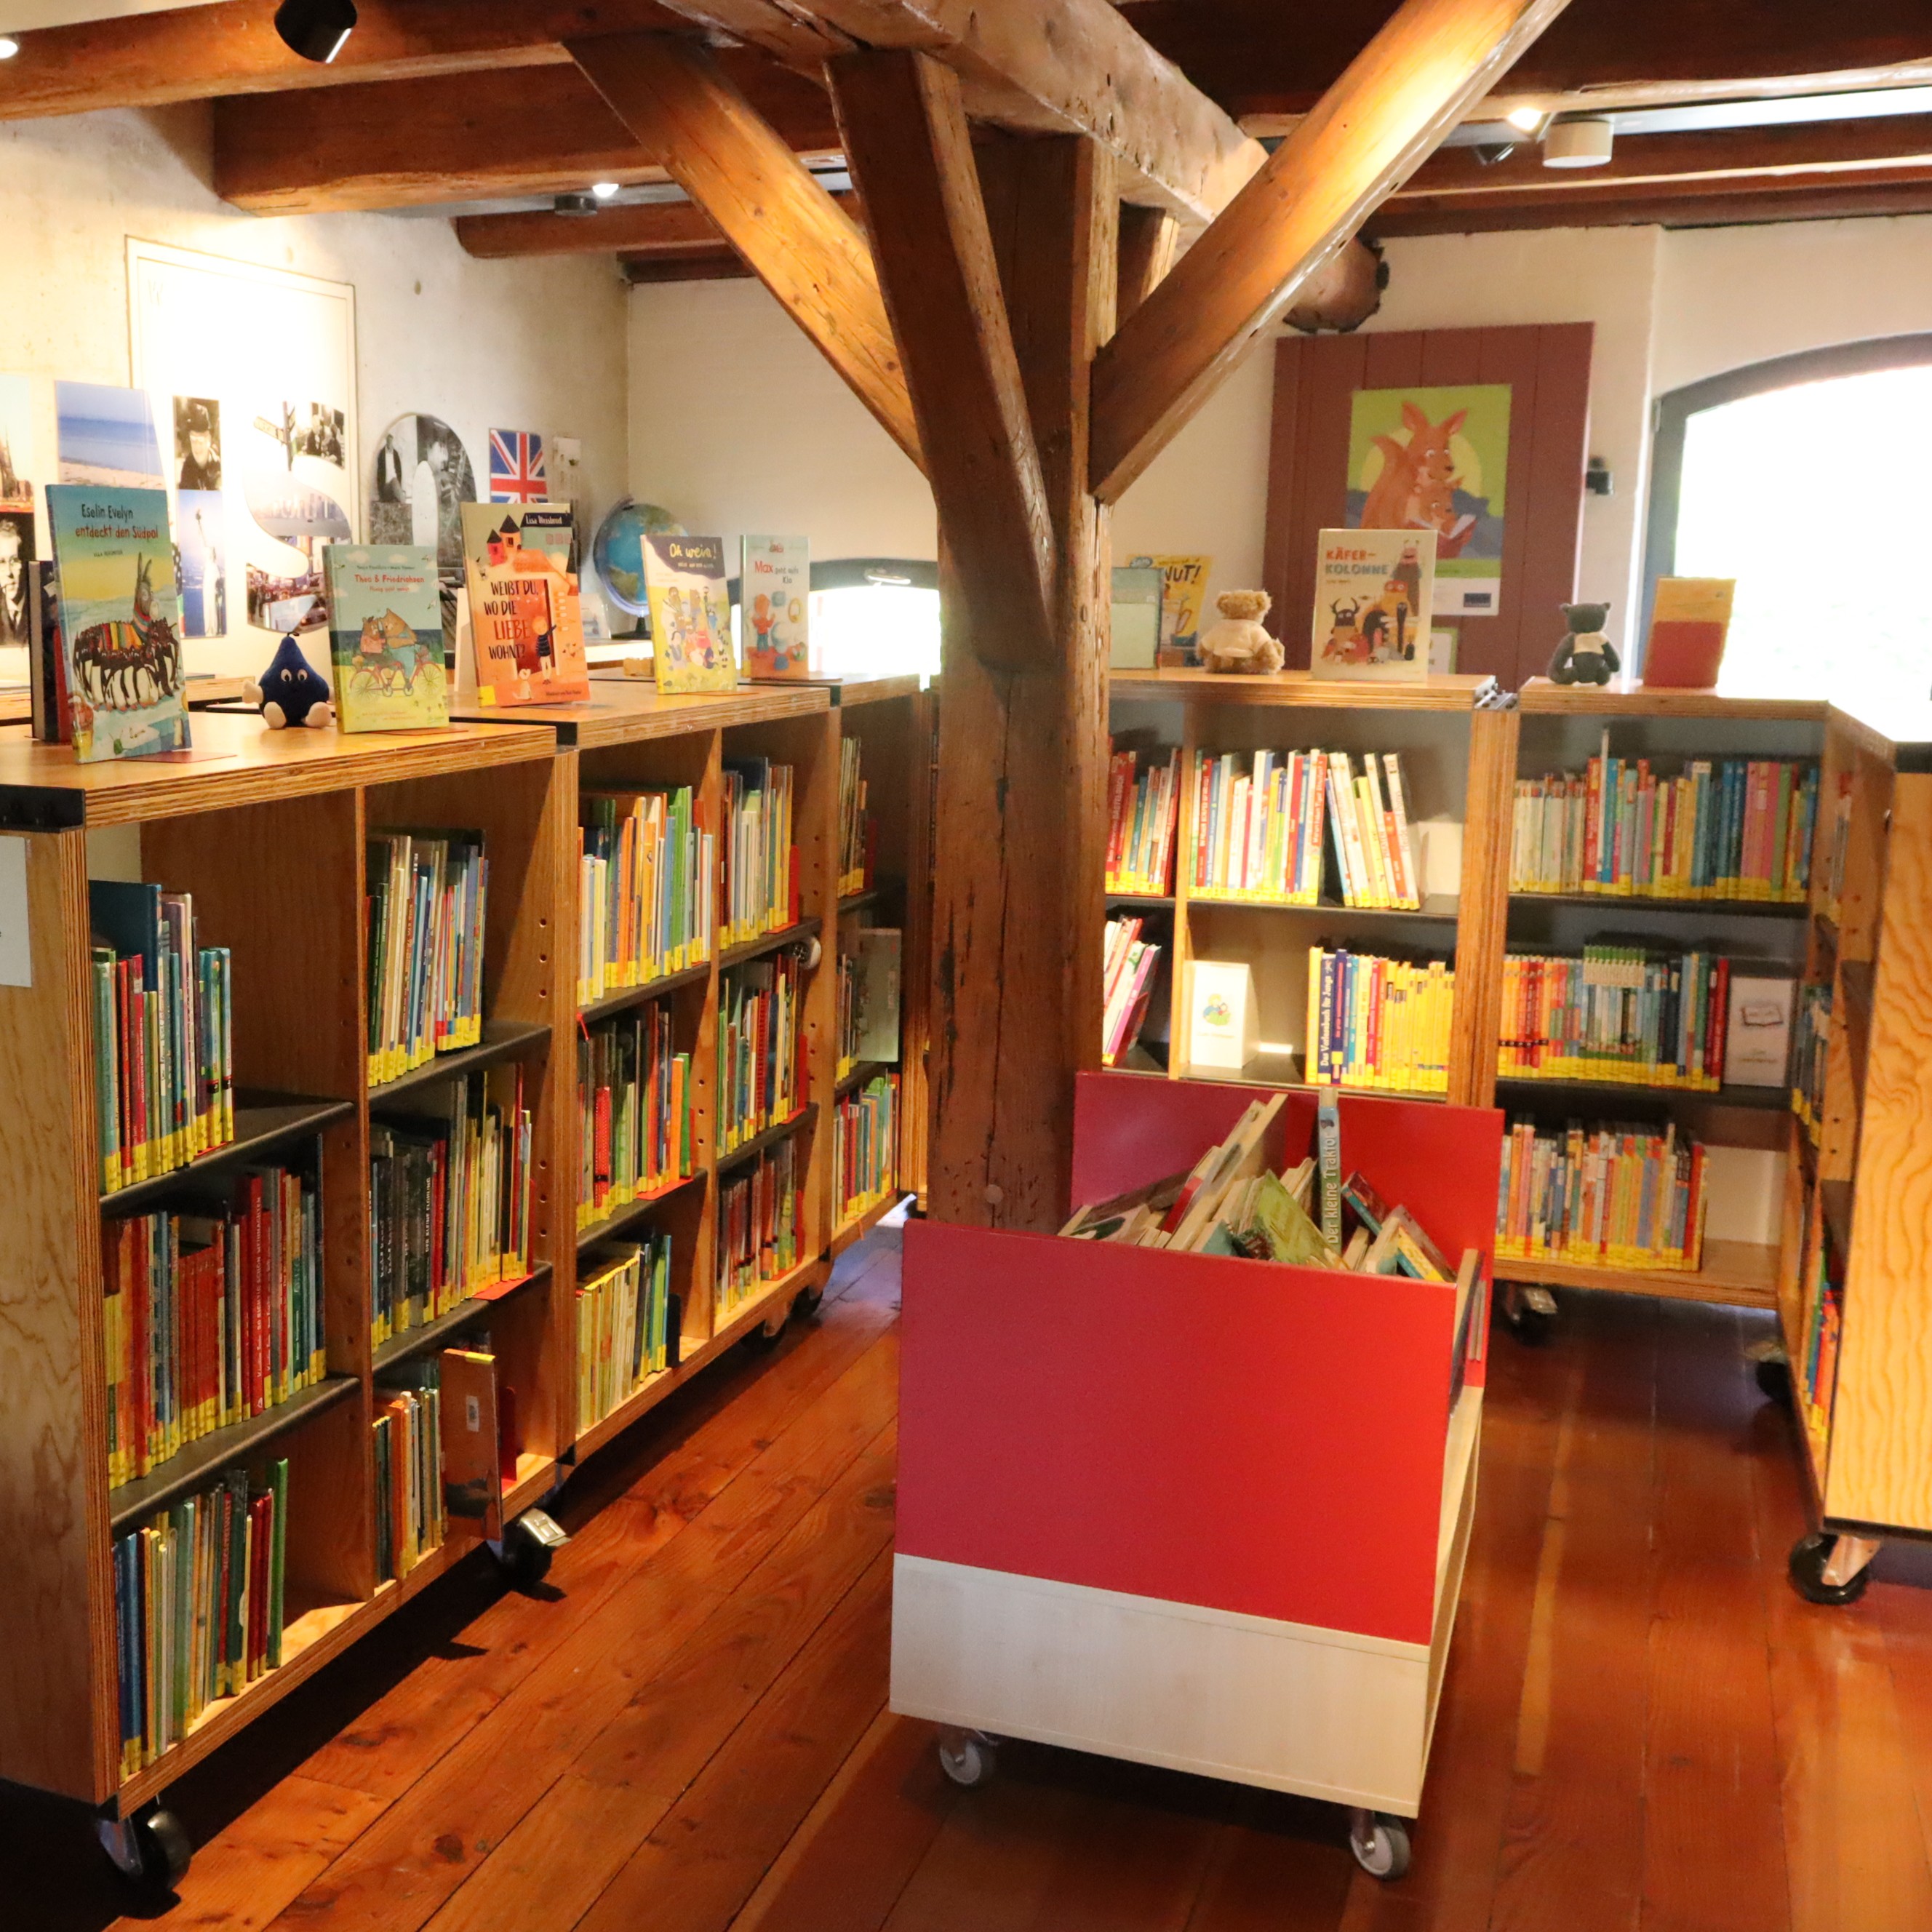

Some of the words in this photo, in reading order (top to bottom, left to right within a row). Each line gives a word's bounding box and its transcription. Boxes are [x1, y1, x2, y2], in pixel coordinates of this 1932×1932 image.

[81, 503, 105, 519] Eselin
[108, 505, 134, 523] Evelyn
[525, 514, 538, 524] Lisa
[75, 524, 112, 538] entdeckt
[116, 524, 129, 538] den
[132, 524, 158, 542] Südpol
[1326, 547, 1376, 560] KÄFER-
[755, 560, 773, 573] Max
[1325, 564, 1388, 575] KOLONNE
[354, 574, 372, 583] Theo
[375, 575, 380, 583] &
[523, 580, 539, 596] DU,
[484, 600, 498, 616] WO
[501, 600, 517, 615] DIE
[493, 620, 530, 641] LIEBE
[488, 644, 526, 660] WOHNT?
[1321, 1053, 1330, 1066] Das
[1322, 1134, 1337, 1178] Traktor
[1324, 1182, 1338, 1218] kleine
[1325, 1222, 1339, 1243] Der
